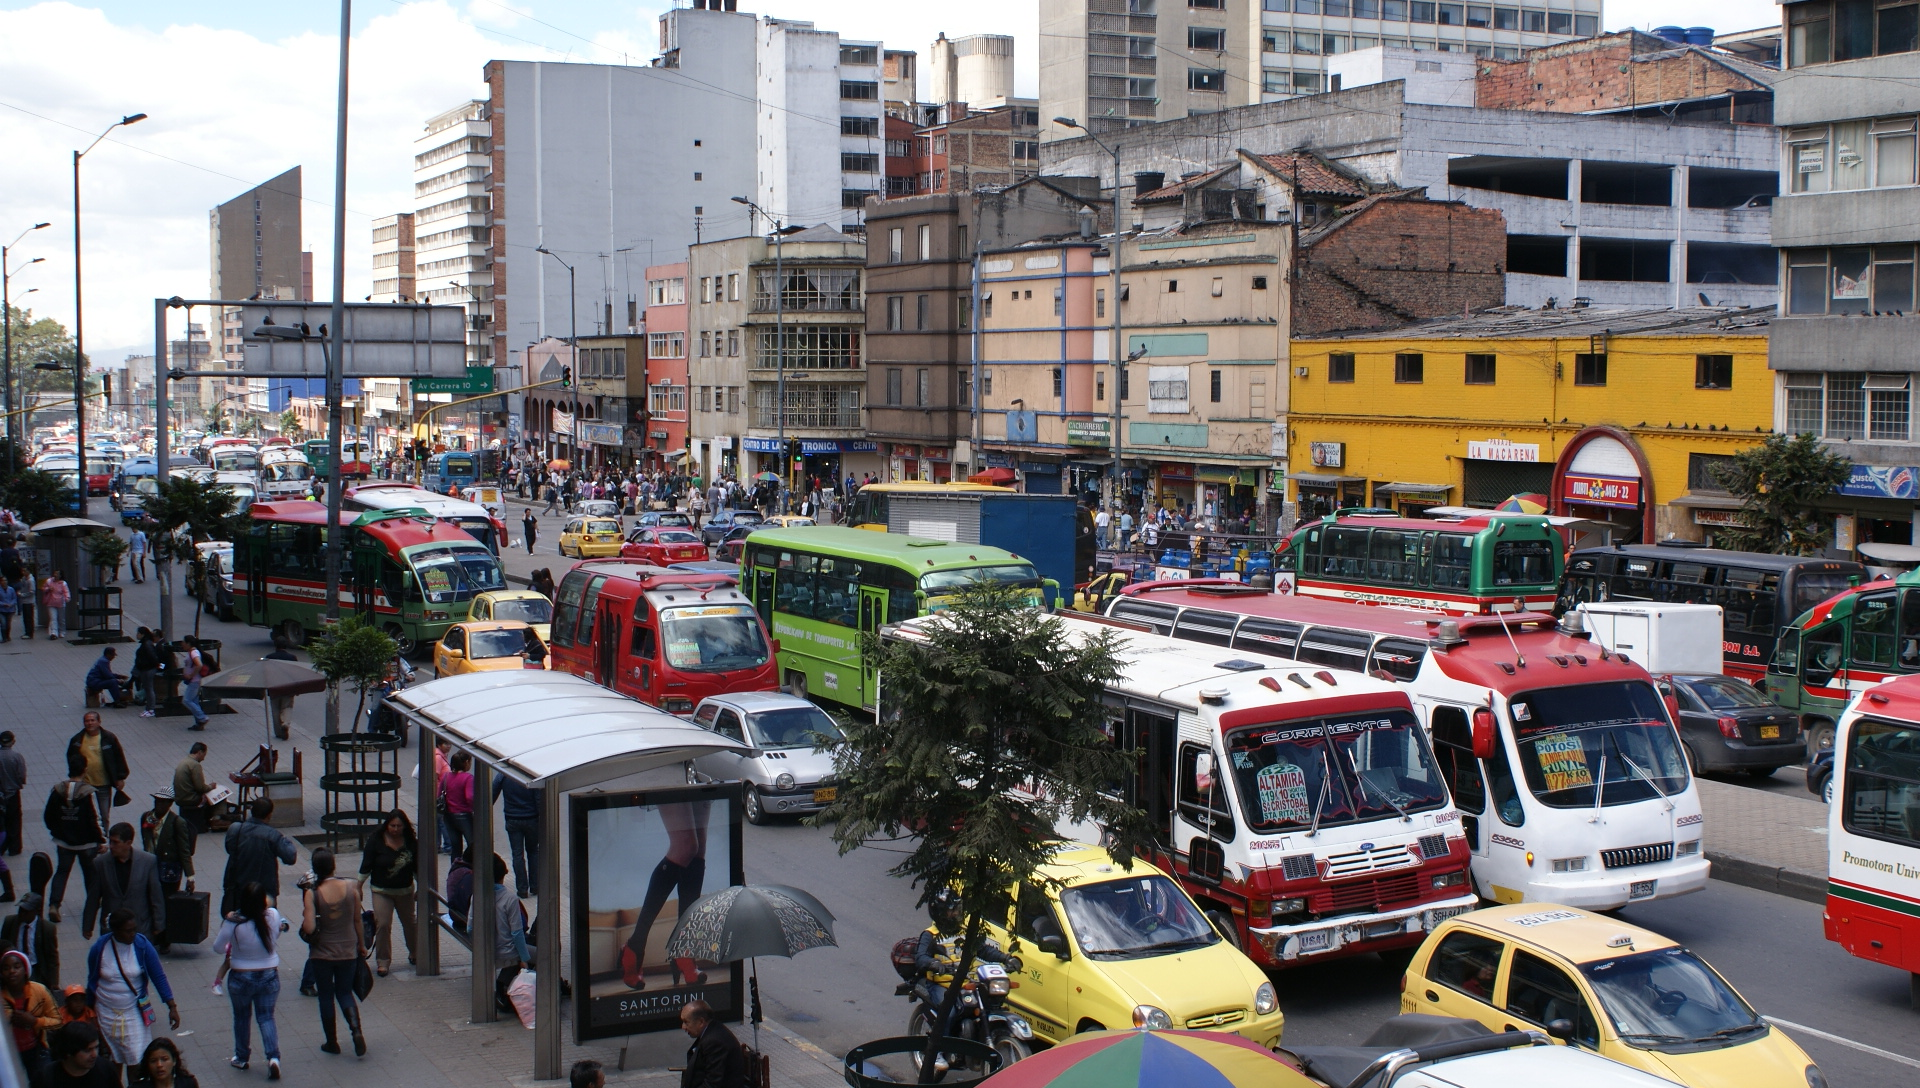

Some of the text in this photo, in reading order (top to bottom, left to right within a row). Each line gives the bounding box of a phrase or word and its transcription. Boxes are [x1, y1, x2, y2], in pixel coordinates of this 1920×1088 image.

[744, 440, 878, 450] CENTRO DE LA TRONICA CENTR
[1490, 438, 1512, 446] PASAJE
[1472, 446, 1535, 461] LA MACARENA
[1850, 474, 1874, 484] gusto
[1697, 510, 1730, 522] EMPANADAS
[806, 631, 812, 640] DE
[814, 633, 844, 648] TRANSPORTES
[1723, 641, 1760, 657] BON S.A.
[1537, 740, 1582, 753] POTOSI
[1540, 750, 1586, 766] CANDELARIA
[1262, 766, 1298, 776] 822
[1542, 760, 1586, 774] TUNAL
[1260, 772, 1304, 792] ALTAMIRA
[1266, 791, 1275, 801] 19
[1280, 788, 1288, 800] 10
[1271, 798, 1308, 810] CRISTOBAL
[1264, 812, 1277, 820] STA
[1279, 810, 1294, 818] RITA
[1843, 850, 1893, 874] Promotora
[689, 912, 717, 921] ATLAS
[698, 922, 723, 932] PANOS
[679, 930, 708, 940] PANOS
[1301, 934, 1326, 948] USA1
[620, 992, 704, 1011] SANTORINI
[620, 1005, 685, 1018] www.santorini.c
[1036, 1020, 1054, 1034] PUBLICO
